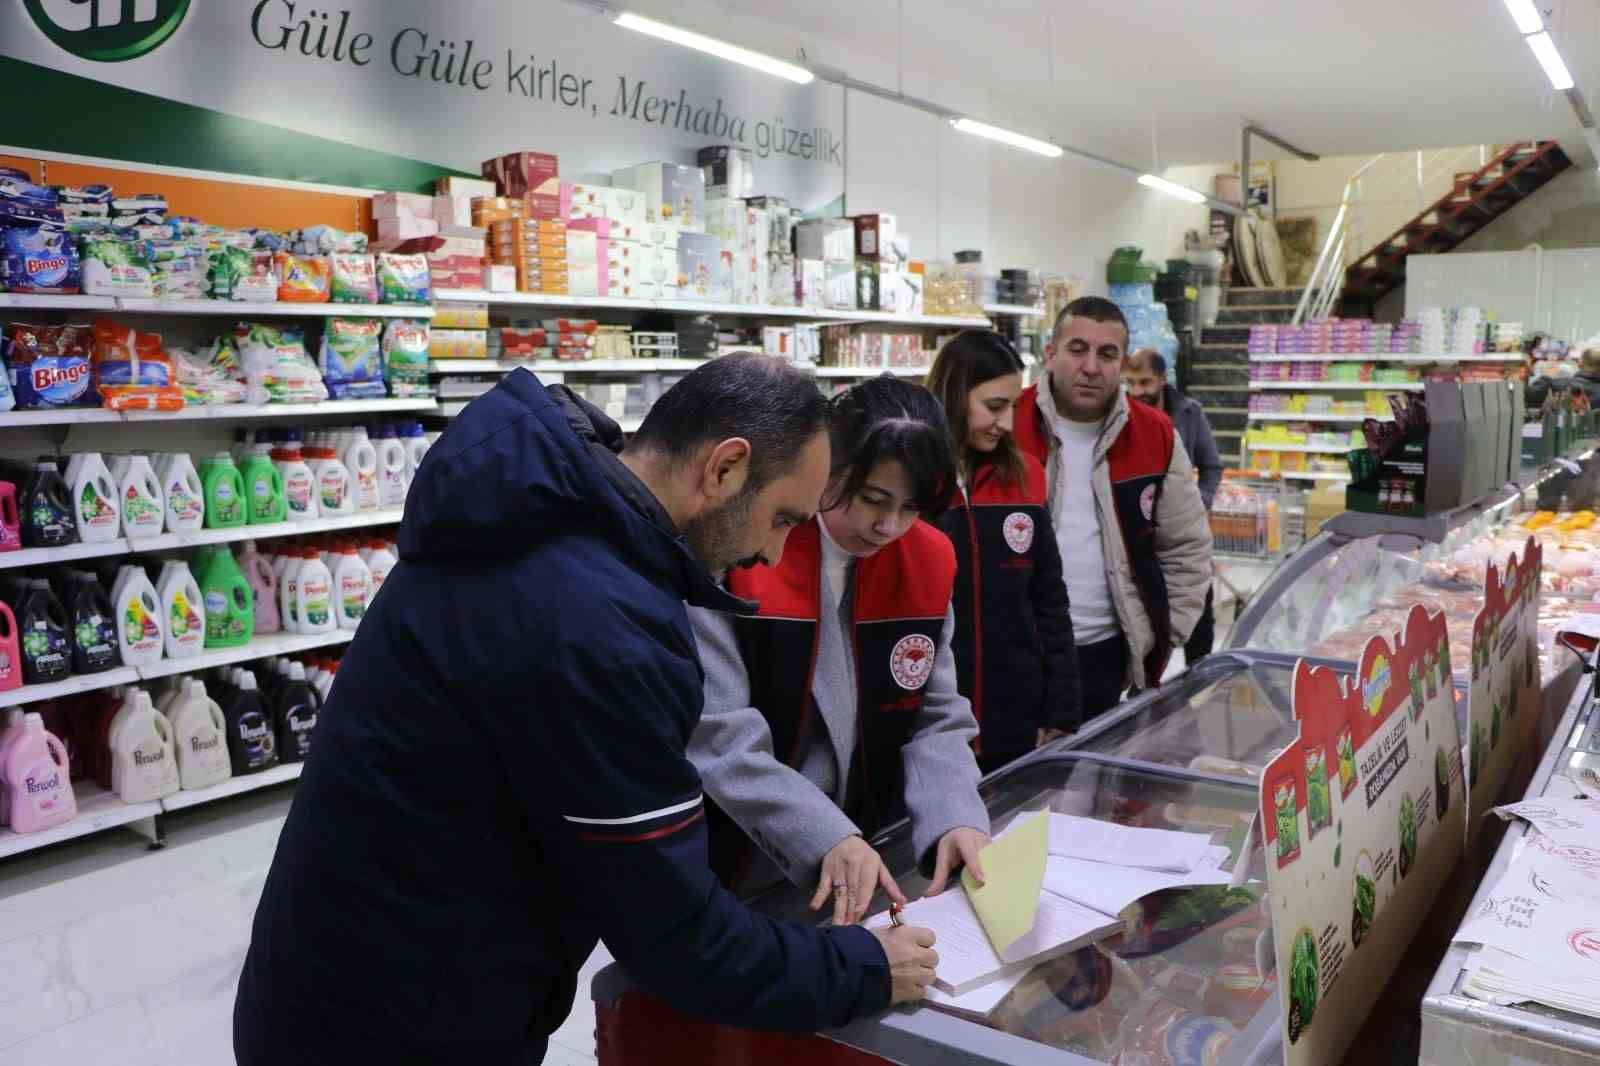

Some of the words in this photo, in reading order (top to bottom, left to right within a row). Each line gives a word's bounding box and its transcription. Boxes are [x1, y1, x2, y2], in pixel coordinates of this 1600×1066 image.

[251, 0, 374, 66] Güle
[391, 28, 493, 90] Güle
[507, 49, 597, 117] kirler,
[609, 76, 748, 143] Merhaba
[756, 118, 841, 166] güzellik
[28, 258, 66, 274] Bingo
[34, 363, 89, 390] Bingo
